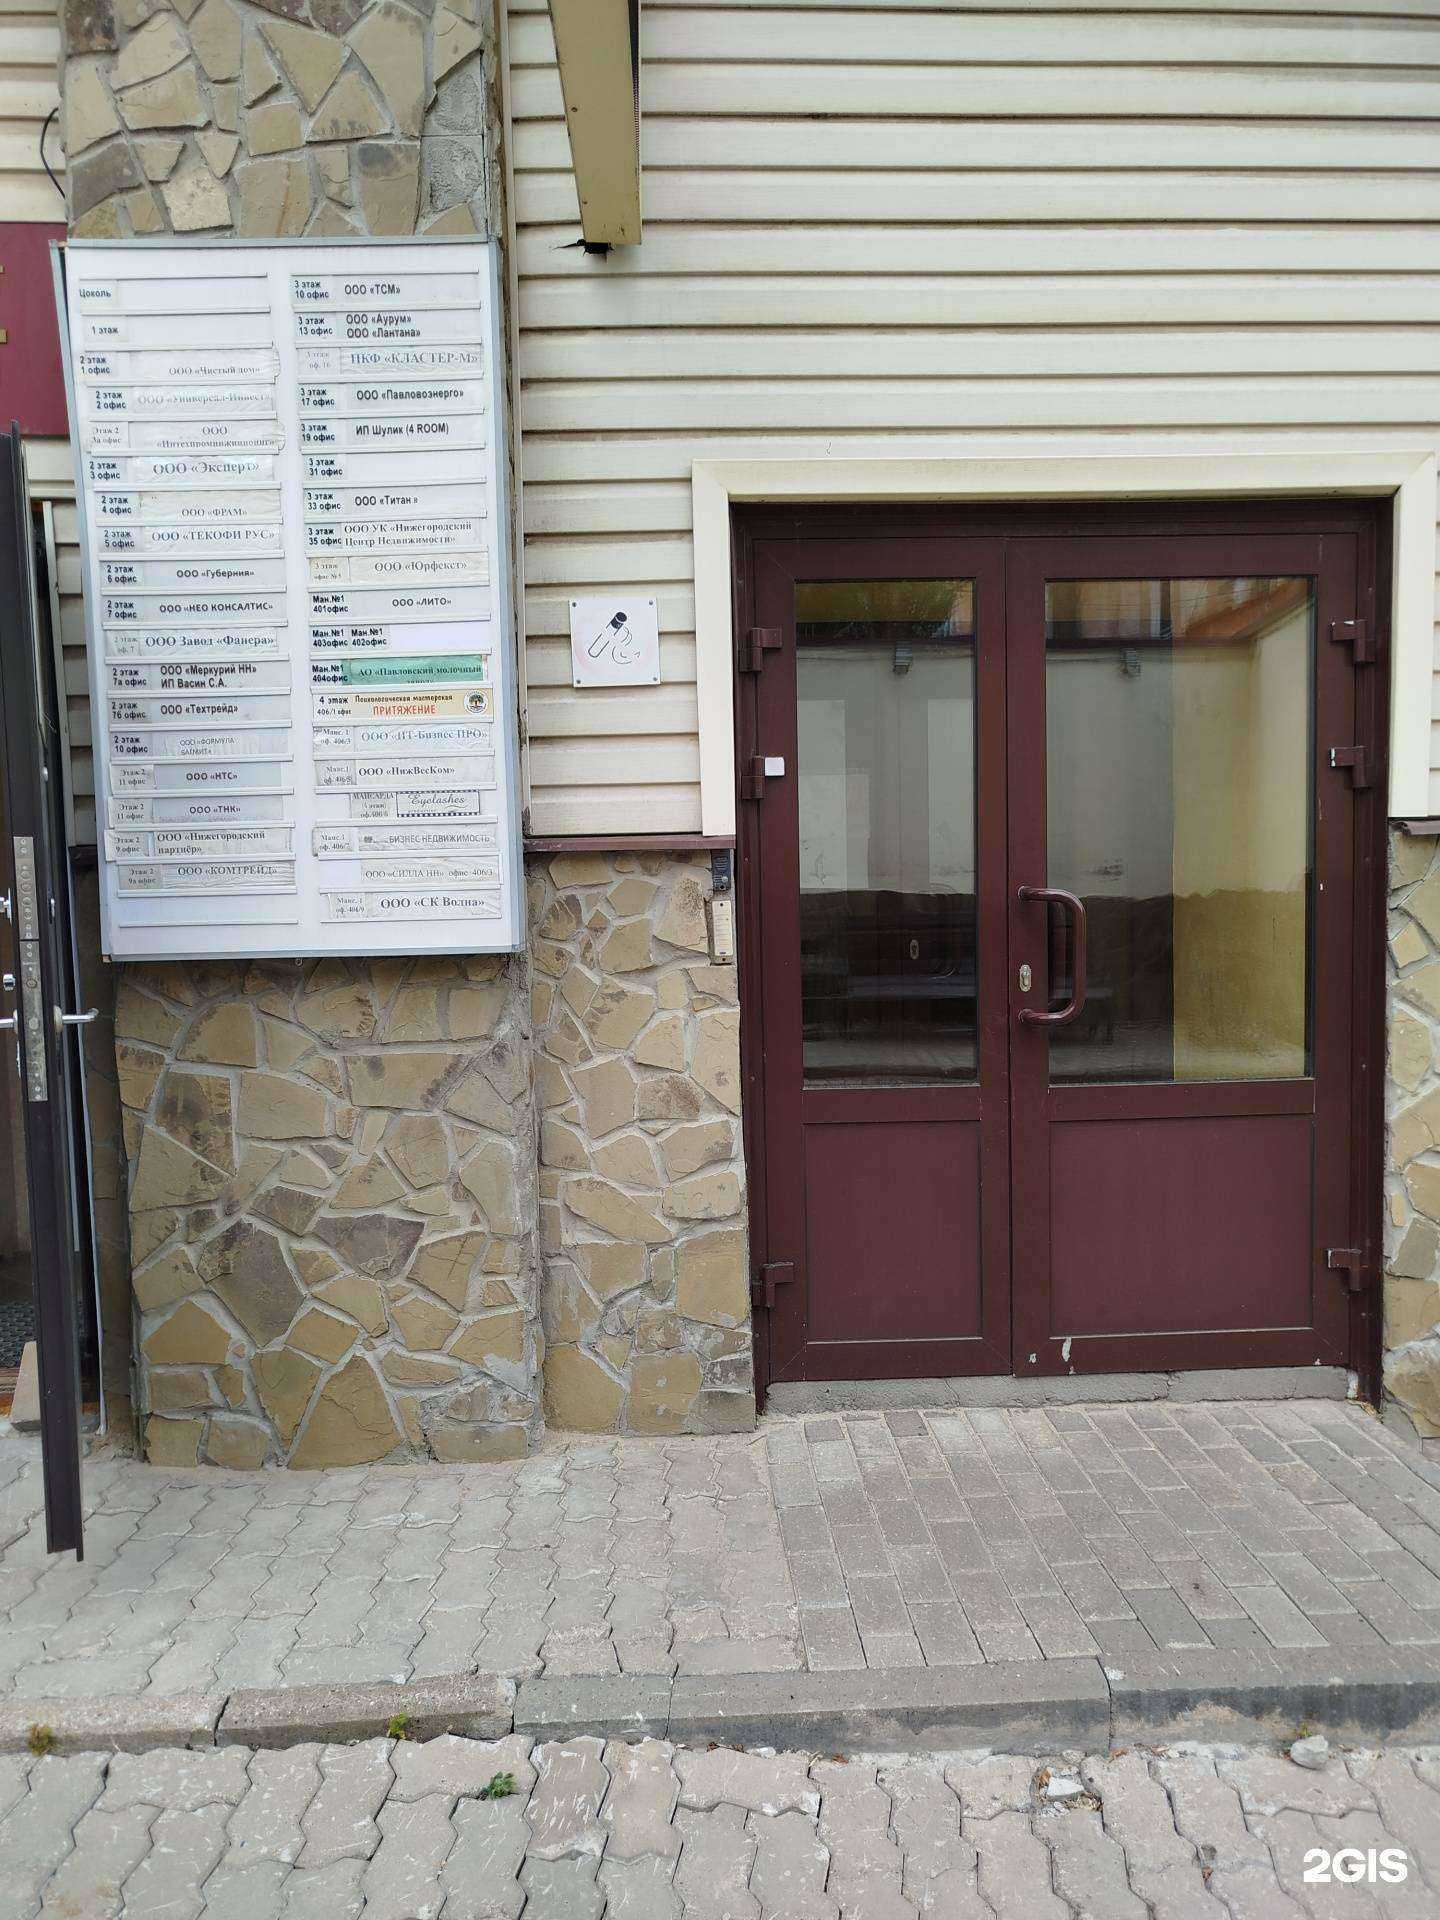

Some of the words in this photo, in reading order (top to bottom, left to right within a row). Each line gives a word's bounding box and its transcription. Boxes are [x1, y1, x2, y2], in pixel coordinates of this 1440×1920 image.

[79, 289, 111, 298] Цоколь
[345, 285, 366, 294] ООО
[370, 284, 400, 294] «ТСМ»
[307, 291, 329, 300] офис
[346, 315, 368, 323] ООО
[371, 314, 411, 326] «Аурум»
[311, 328, 332, 336] офис
[347, 329, 368, 338] ООО
[372, 329, 420, 337] «Лантана»
[352, 354, 381, 364] ПКФ
[384, 353, 477, 363] «КЛАСТЕР-М»
[88, 367, 110, 375] офис
[357, 391, 378, 399] ООО
[382, 390, 464, 400] «Павловоэнерго»
[104, 402, 126, 410] офис
[313, 399, 334, 407] офис
[356, 426, 369, 435] ИП
[373, 425, 403, 436] Шулик
[417, 424, 448, 434] ROOM)
[313, 434, 335, 442] офис
[153, 463, 187, 474] ООО
[192, 463, 260, 473] «Эксперт»
[98, 472, 120, 480] офис
[355, 497, 376, 505] ООО
[320, 503, 341, 511] офис
[345, 526, 368, 534] ООО
[372, 525, 387, 533] УК
[391, 522, 472, 532] «Нижегородский
[183, 531, 241, 540] «ТЕКОФИ
[245, 530, 275, 539] РУС»
[321, 538, 341, 546] офис
[375, 562, 400, 571] ООО
[202, 570, 254, 578] «Губерния»
[115, 576, 137, 584] офис
[416, 598, 451, 606] «ЛИТО»
[184, 604, 208, 612] «НЕО
[211, 603, 273, 611] КОНСАЛТИС»
[146, 637, 176, 646] ООО
[181, 637, 213, 646] Завод
[160, 666, 182, 674] ООО
[185, 665, 236, 675] «Меркурий
[239, 665, 256, 673] НН»
[161, 680, 174, 688] ИП
[178, 680, 206, 688] Васин
[209, 679, 227, 687] С.А.
[161, 705, 182, 714] ООО
[186, 705, 238, 714] «Техтрейд»
[374, 705, 436, 715] ПРИТЯЖЕНИЕ
[125, 712, 146, 720] офис
[362, 732, 388, 741] ООО
[127, 746, 148, 754] офис
[359, 767, 383, 776] ООО
[157, 834, 181, 842] ООО
[185, 832, 265, 842] «Нижегородский
[178, 867, 202, 876] ООО
[206, 865, 277, 875] «КОМТРЕЙД»
[381, 900, 410, 908] ООО
[414, 899, 438, 907] «СК
[443, 898, 484, 906] Волна»
